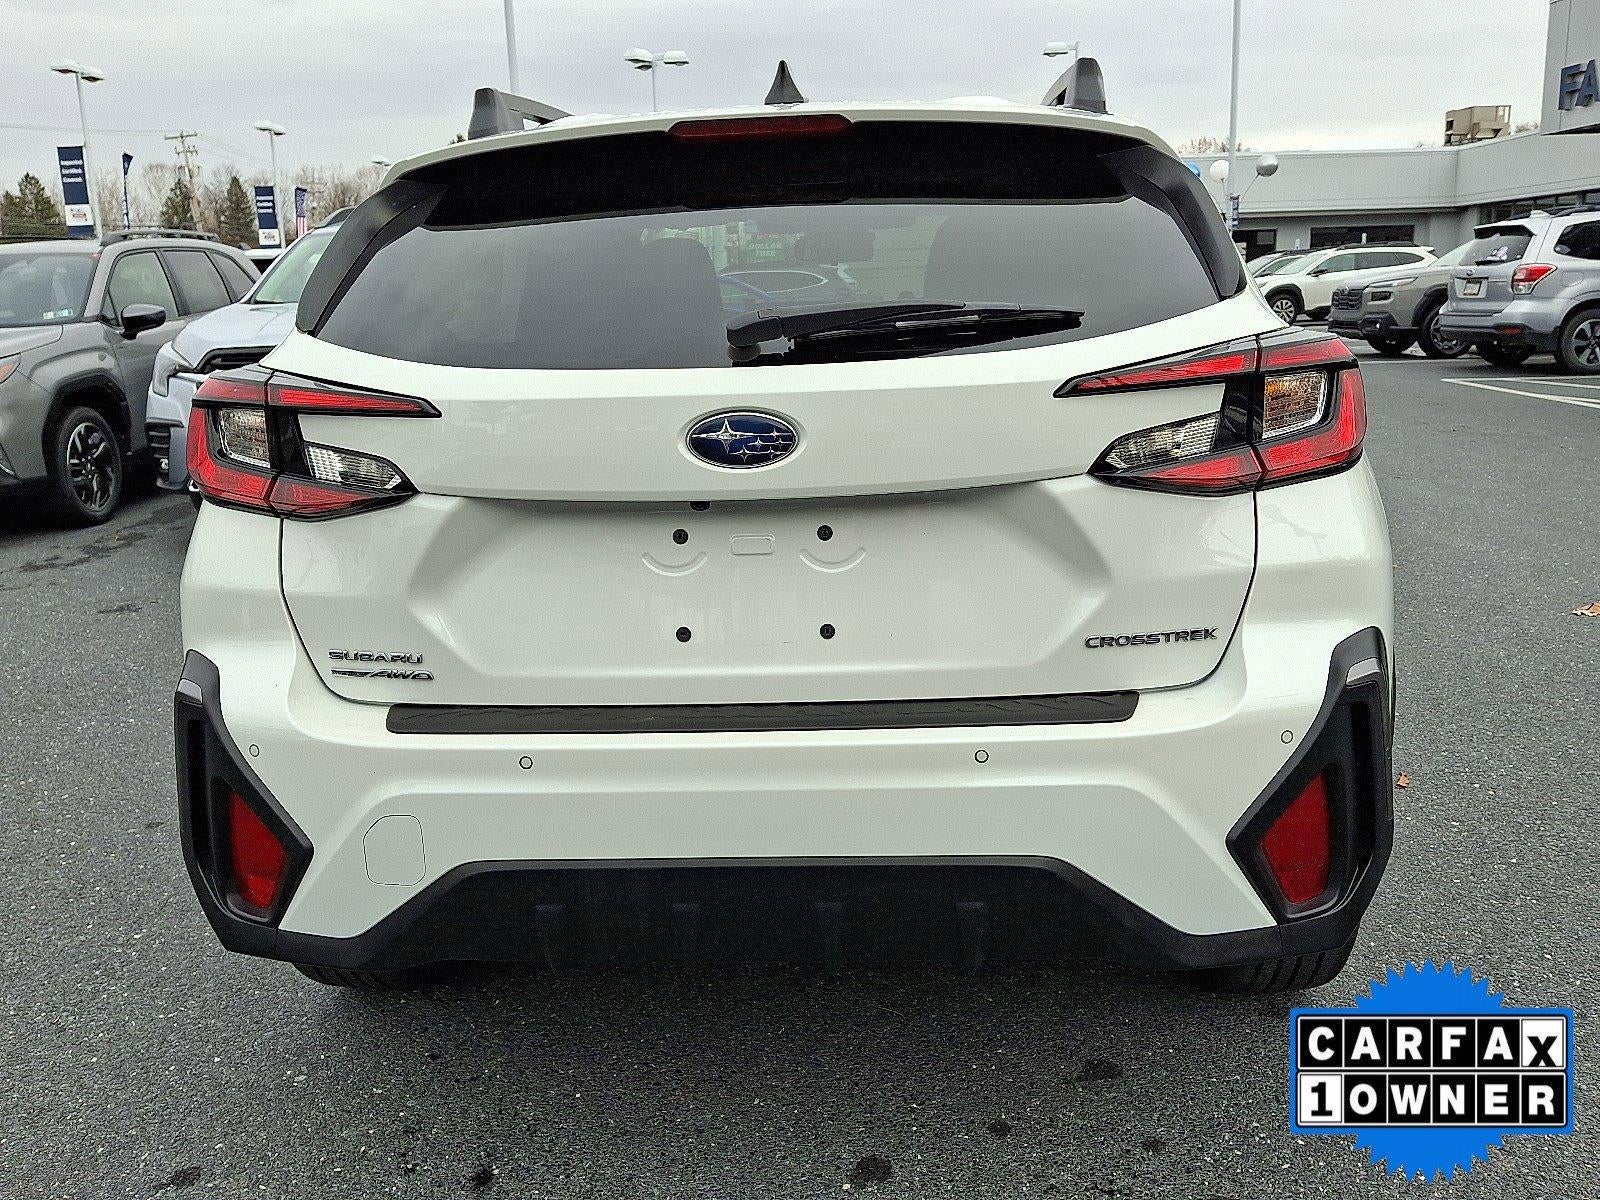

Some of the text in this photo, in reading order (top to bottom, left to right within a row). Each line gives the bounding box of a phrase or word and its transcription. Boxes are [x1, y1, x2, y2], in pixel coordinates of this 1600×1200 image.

[1084, 626, 1219, 649] CROSSTREK
[328, 649, 423, 664] SUBARU
[369, 669, 435, 681] AWD
